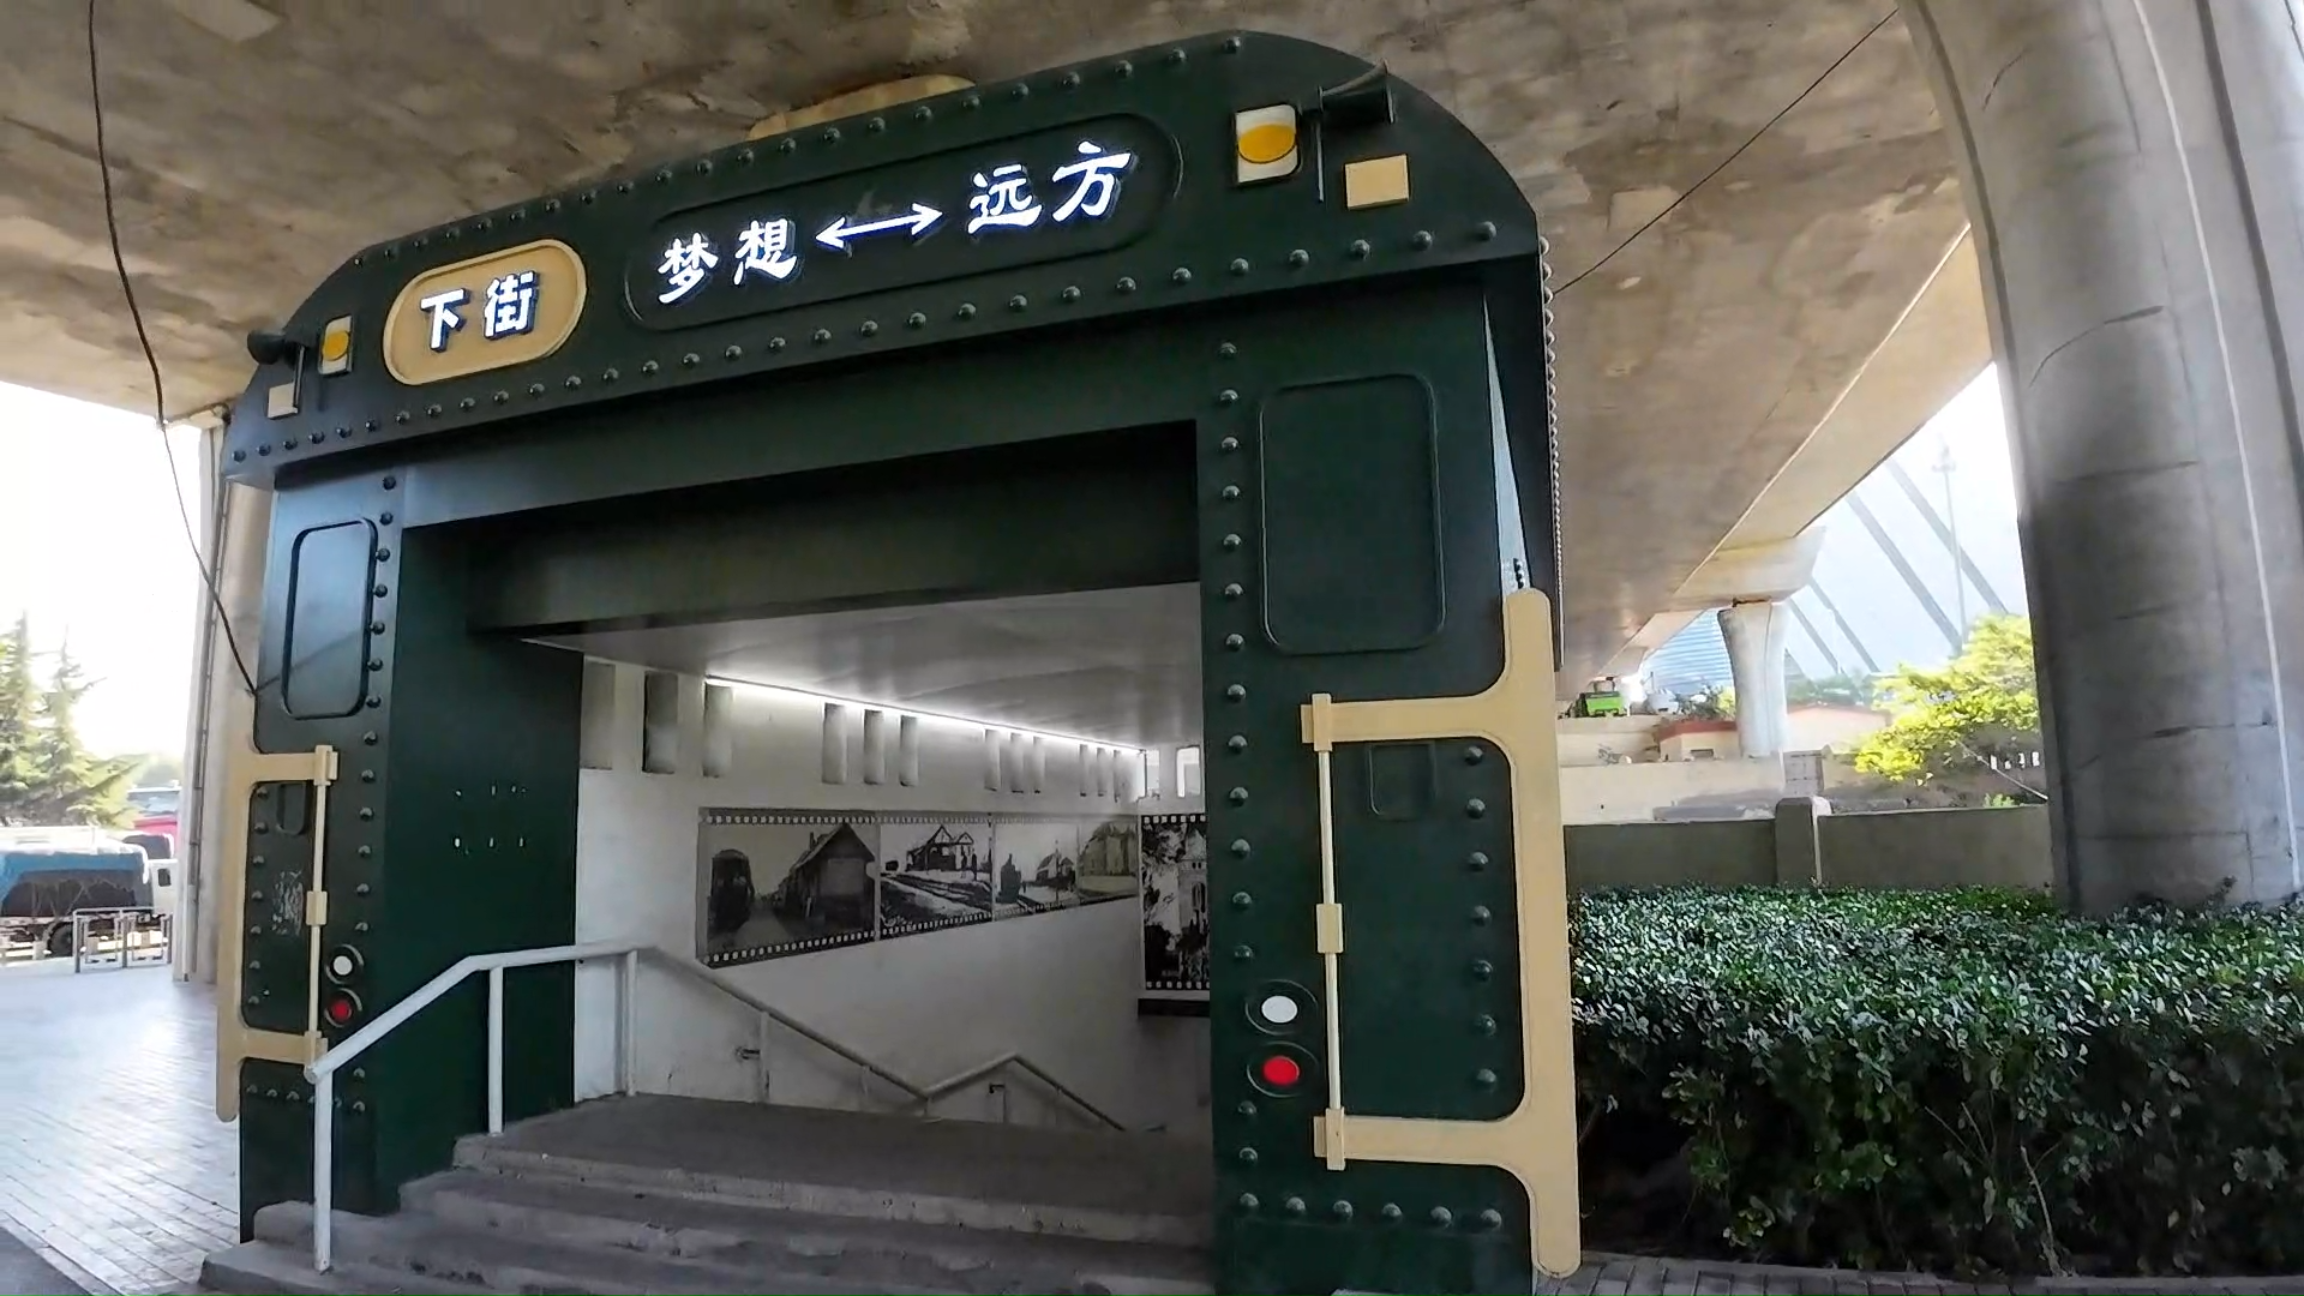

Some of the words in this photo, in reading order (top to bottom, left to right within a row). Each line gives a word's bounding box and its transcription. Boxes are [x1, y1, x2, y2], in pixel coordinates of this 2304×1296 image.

[657, 217, 799, 305] 梦想
[967, 141, 1134, 235] 远方
[420, 270, 538, 351] 下街
